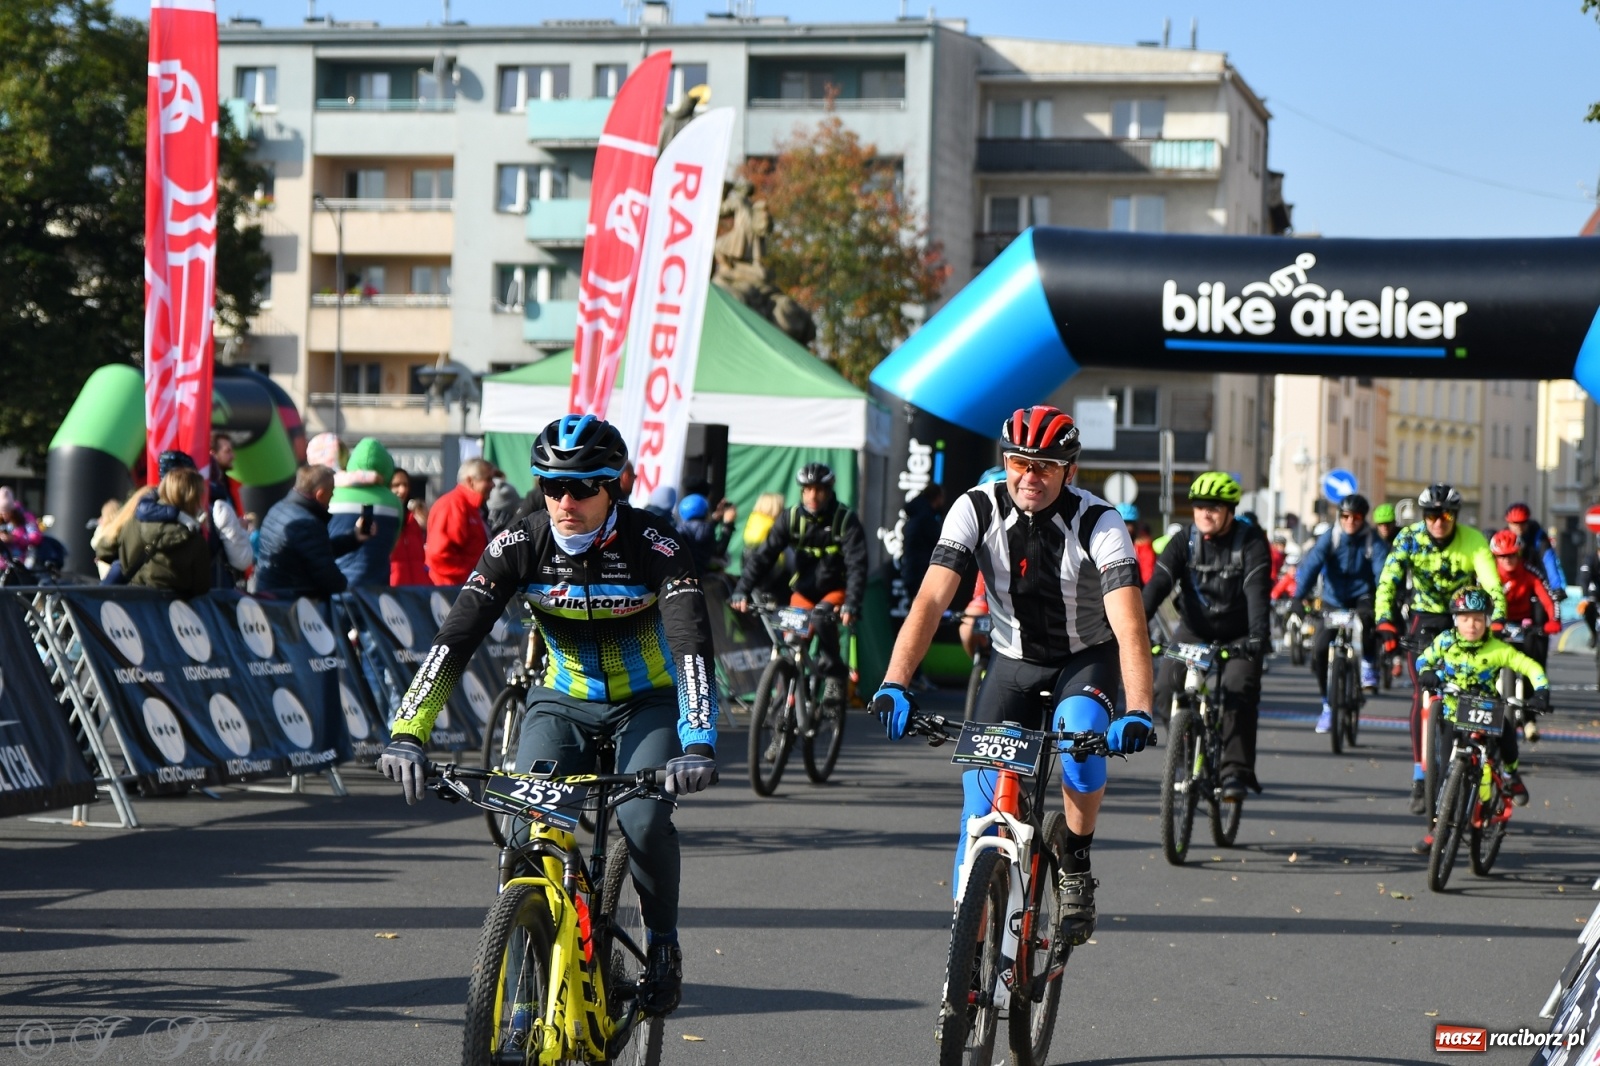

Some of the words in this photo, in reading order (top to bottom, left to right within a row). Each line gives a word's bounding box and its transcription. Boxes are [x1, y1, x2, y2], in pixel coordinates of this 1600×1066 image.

[1162, 279, 1276, 335] bike
[1290, 286, 1468, 340] atelier
[636, 161, 703, 499] RACIBÓRZ
[898, 437, 932, 503] lier
[554, 597, 644, 609] Viktoria
[247, 661, 293, 676] KOKOwear
[427, 644, 450, 681] Grupa
[114, 667, 165, 684] KOKOwear
[182, 665, 231, 681] KOKOwear
[683, 654, 698, 710] Kolarska
[695, 653, 709, 697] Rybnik
[1468, 709, 1493, 725] 175
[971, 734, 1029, 750] OPIEKUN
[973, 742, 1017, 760] 303
[156, 765, 206, 784] KOKOwear
[226, 758, 271, 776] KOKOwear
[510, 780, 562, 810] 252
